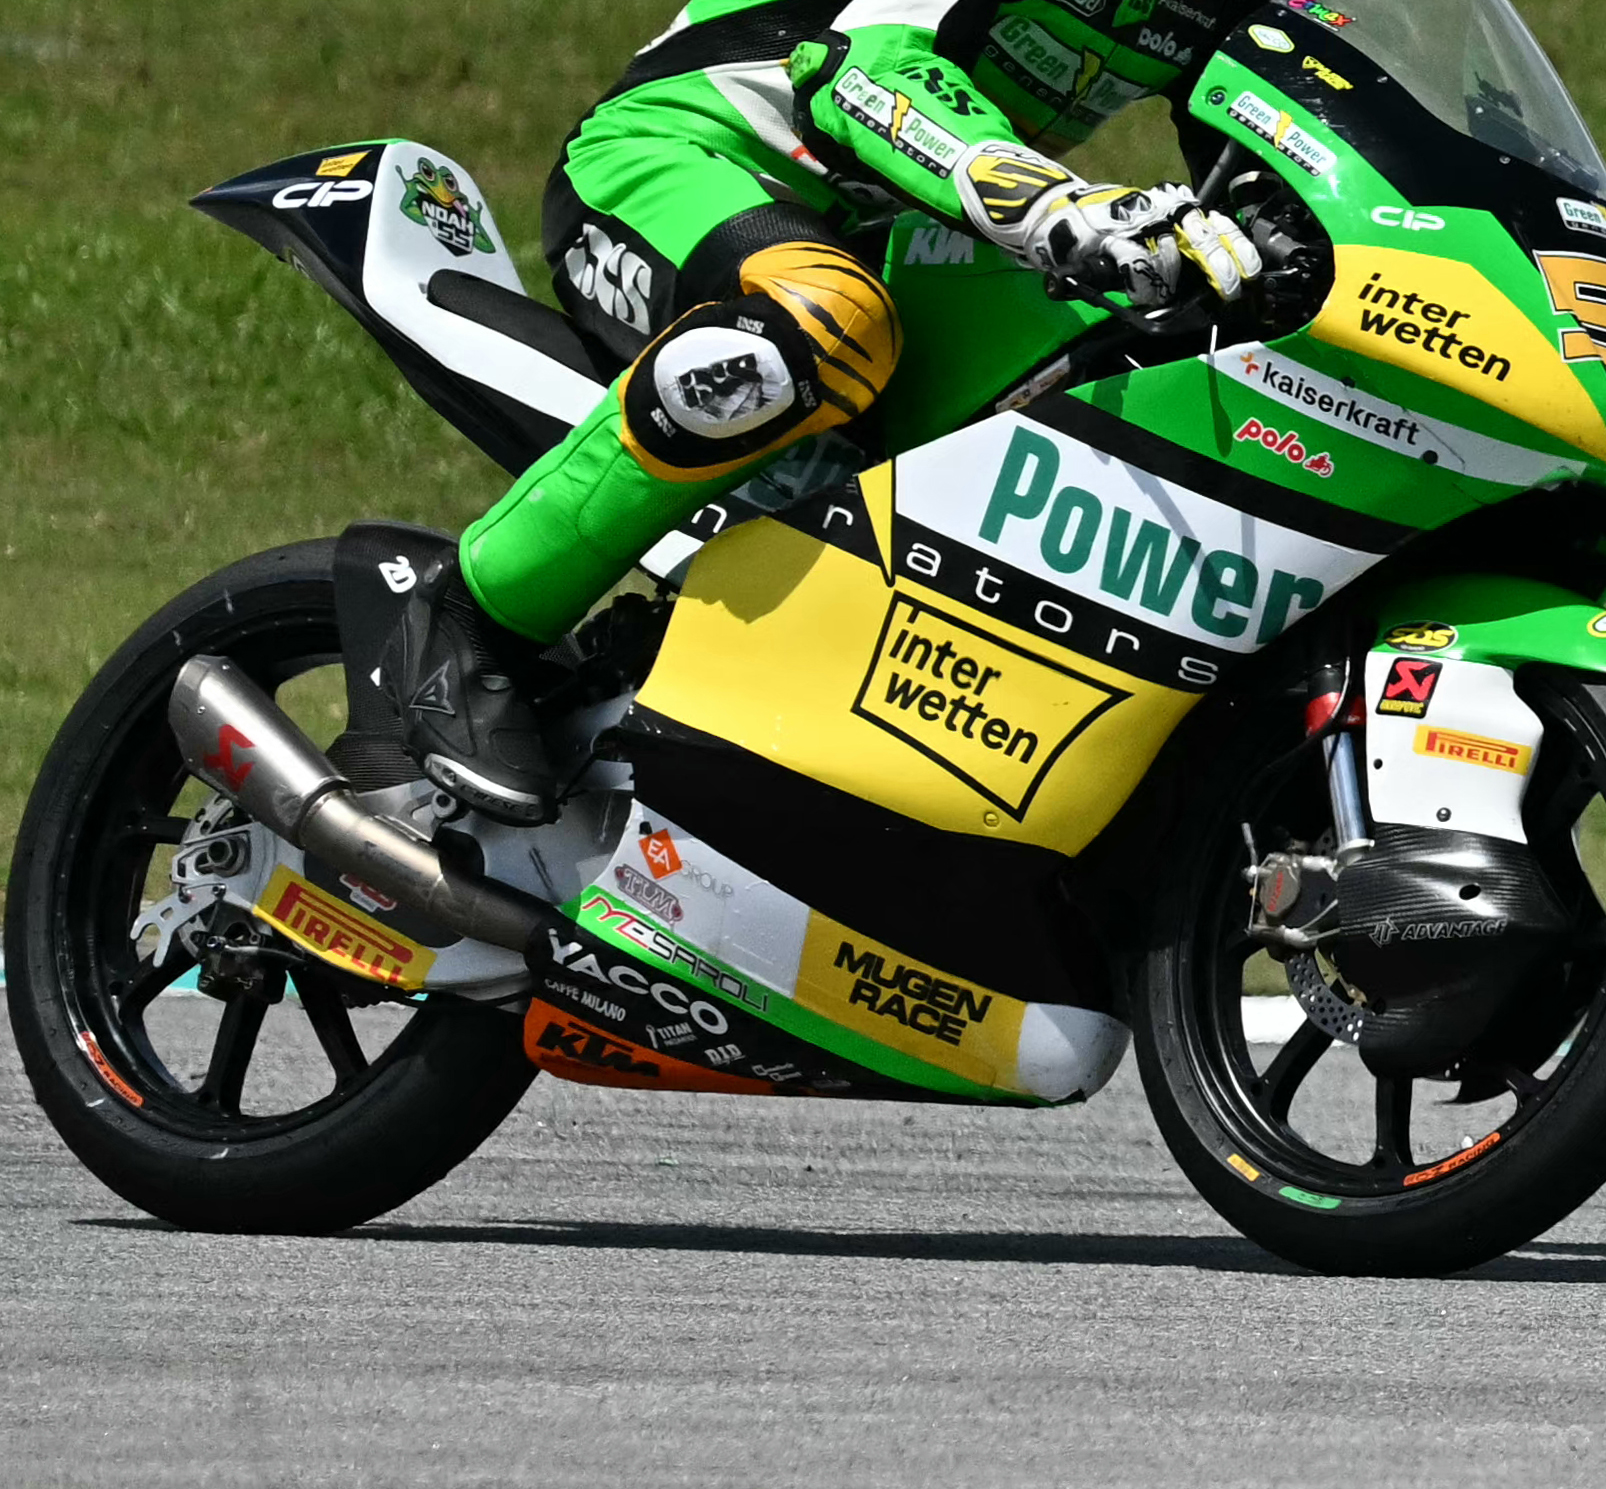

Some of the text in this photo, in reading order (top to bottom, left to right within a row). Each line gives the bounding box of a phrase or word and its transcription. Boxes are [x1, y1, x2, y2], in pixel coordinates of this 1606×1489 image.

[1000, 16, 1069, 79] Green
[1137, 26, 1175, 56] polo
[841, 71, 886, 113] Green
[1237, 95, 1271, 125] Green
[905, 117, 956, 159] Power
[1287, 132, 1327, 165] Power
[272, 180, 373, 209] CIP
[1563, 202, 1602, 223] Green
[422, 200, 475, 234] NOAH
[1370, 205, 1445, 231] CIP
[904, 227, 975, 264] KTM
[1358, 272, 1470, 329] inter
[1359, 308, 1511, 382] wetten
[1263, 362, 1420, 446] kaiserkraft
[1236, 418, 1306, 463] polo
[978, 424, 1324, 646] Power
[888, 606, 1002, 697] inter
[885, 674, 1039, 766] wetten
[1426, 731, 1519, 769] PIRELLI
[680, 859, 734, 898] GROUP
[272, 881, 413, 984] PIRELLI
[1402, 918, 1508, 943] ADVANTAGE
[547, 927, 729, 1035] YACCO
[833, 941, 992, 1023] MUGEN
[581, 990, 627, 1022] MILANO
[848, 978, 967, 1047] RACE
[535, 1021, 661, 1078] KTM
[657, 1022, 694, 1041] TITAN
